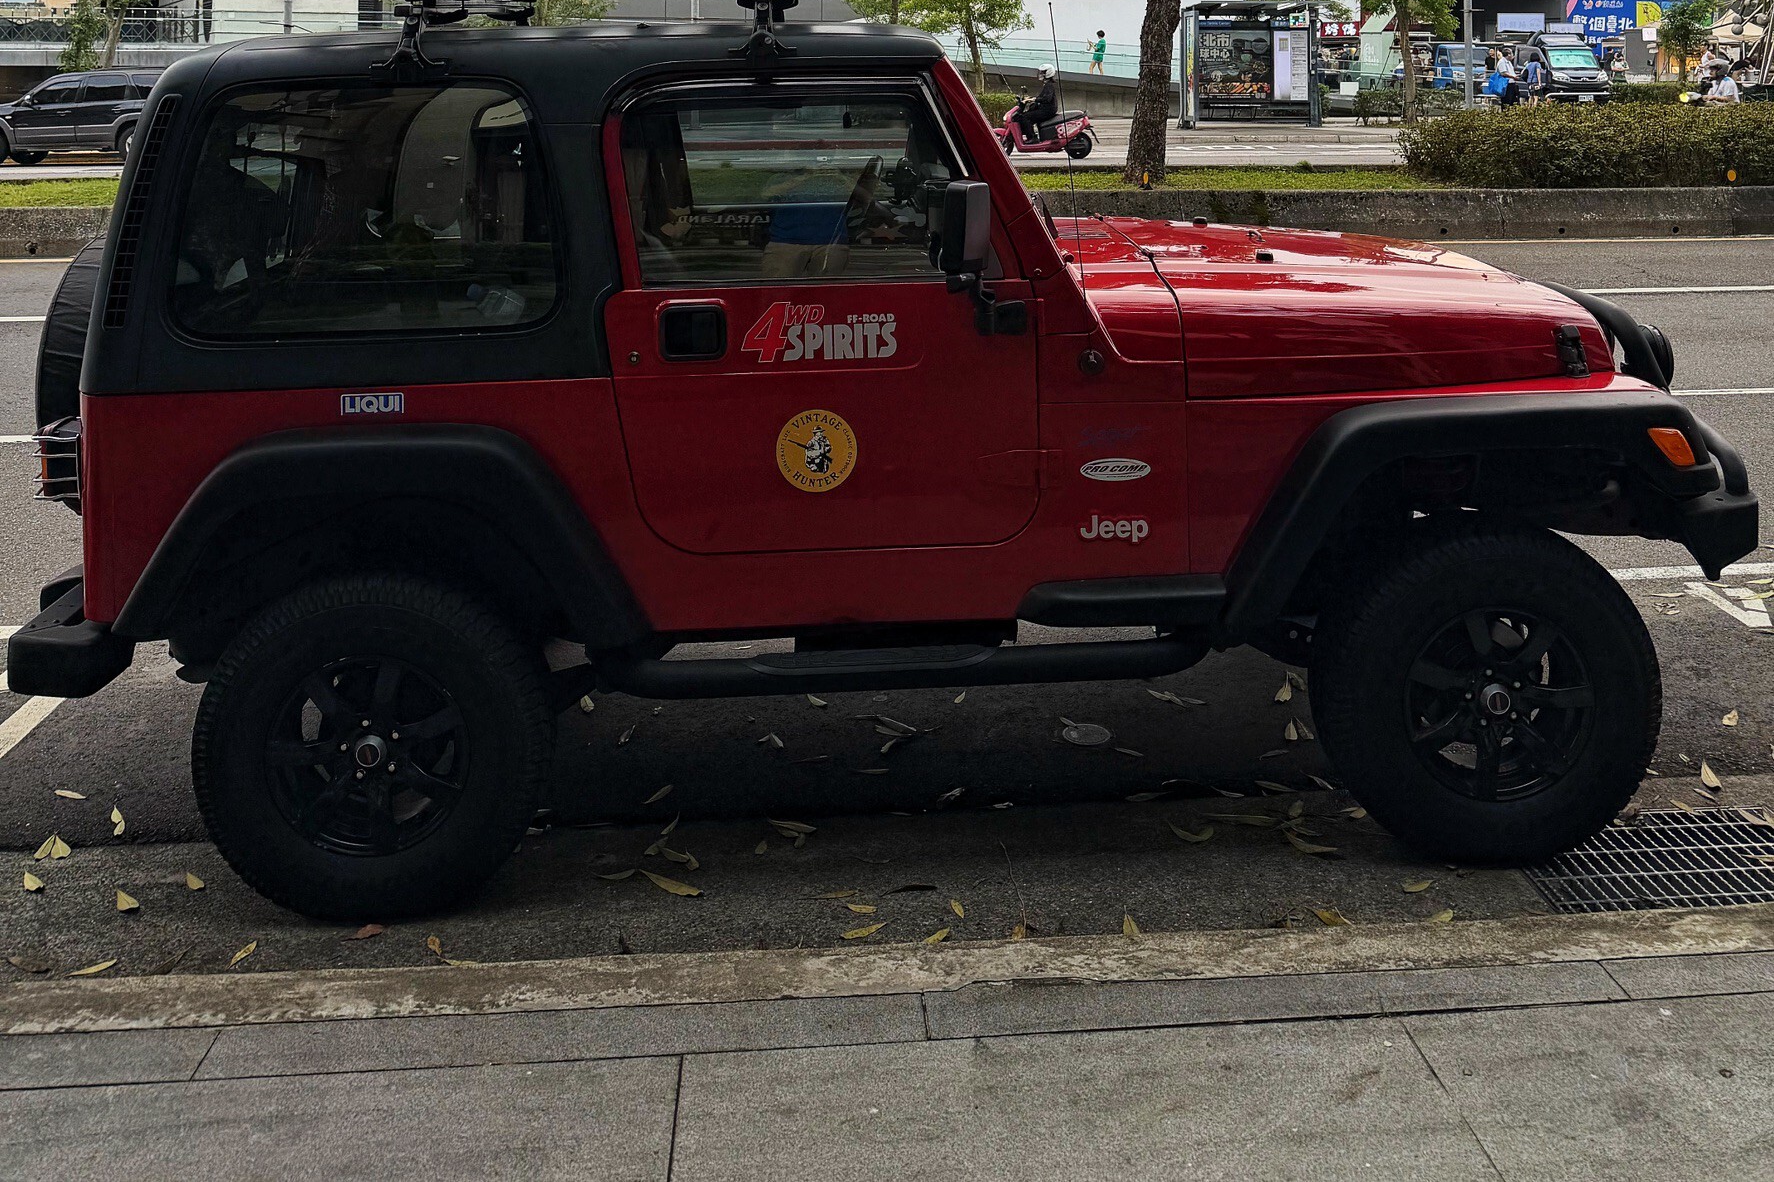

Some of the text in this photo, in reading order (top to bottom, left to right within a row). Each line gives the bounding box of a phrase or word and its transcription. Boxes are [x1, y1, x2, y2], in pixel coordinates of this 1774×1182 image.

[741, 301, 825, 363] 4WD
[783, 322, 898, 362] SPIRITS
[344, 395, 400, 414] LIQUI
[791, 413, 843, 431] VINTAGE
[1082, 464, 1148, 473] PRO COMP
[792, 471, 840, 488] HUNTER
[1080, 514, 1149, 543] Jeep
